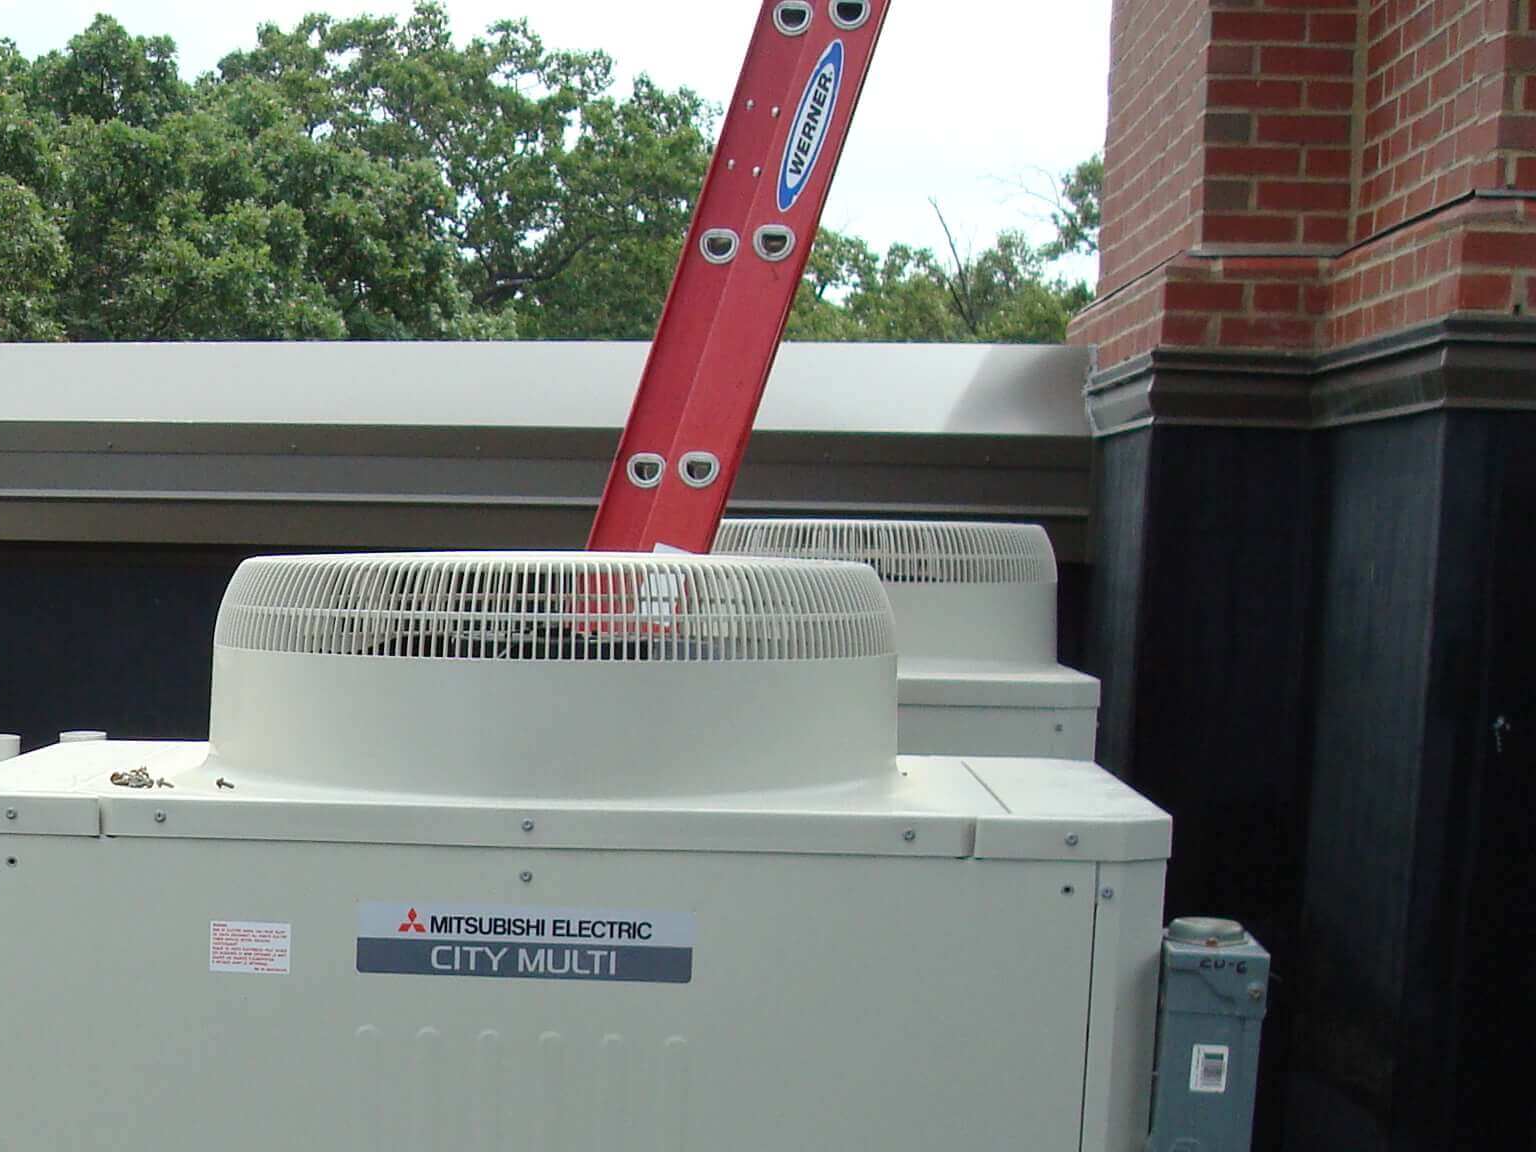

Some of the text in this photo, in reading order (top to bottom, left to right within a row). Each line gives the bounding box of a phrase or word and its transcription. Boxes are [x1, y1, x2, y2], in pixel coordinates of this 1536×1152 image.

[789, 72, 833, 176] WERNER
[430, 916, 652, 940] MITSUBISHI ELECTRIC
[430, 945, 616, 975] CITY MULTI
